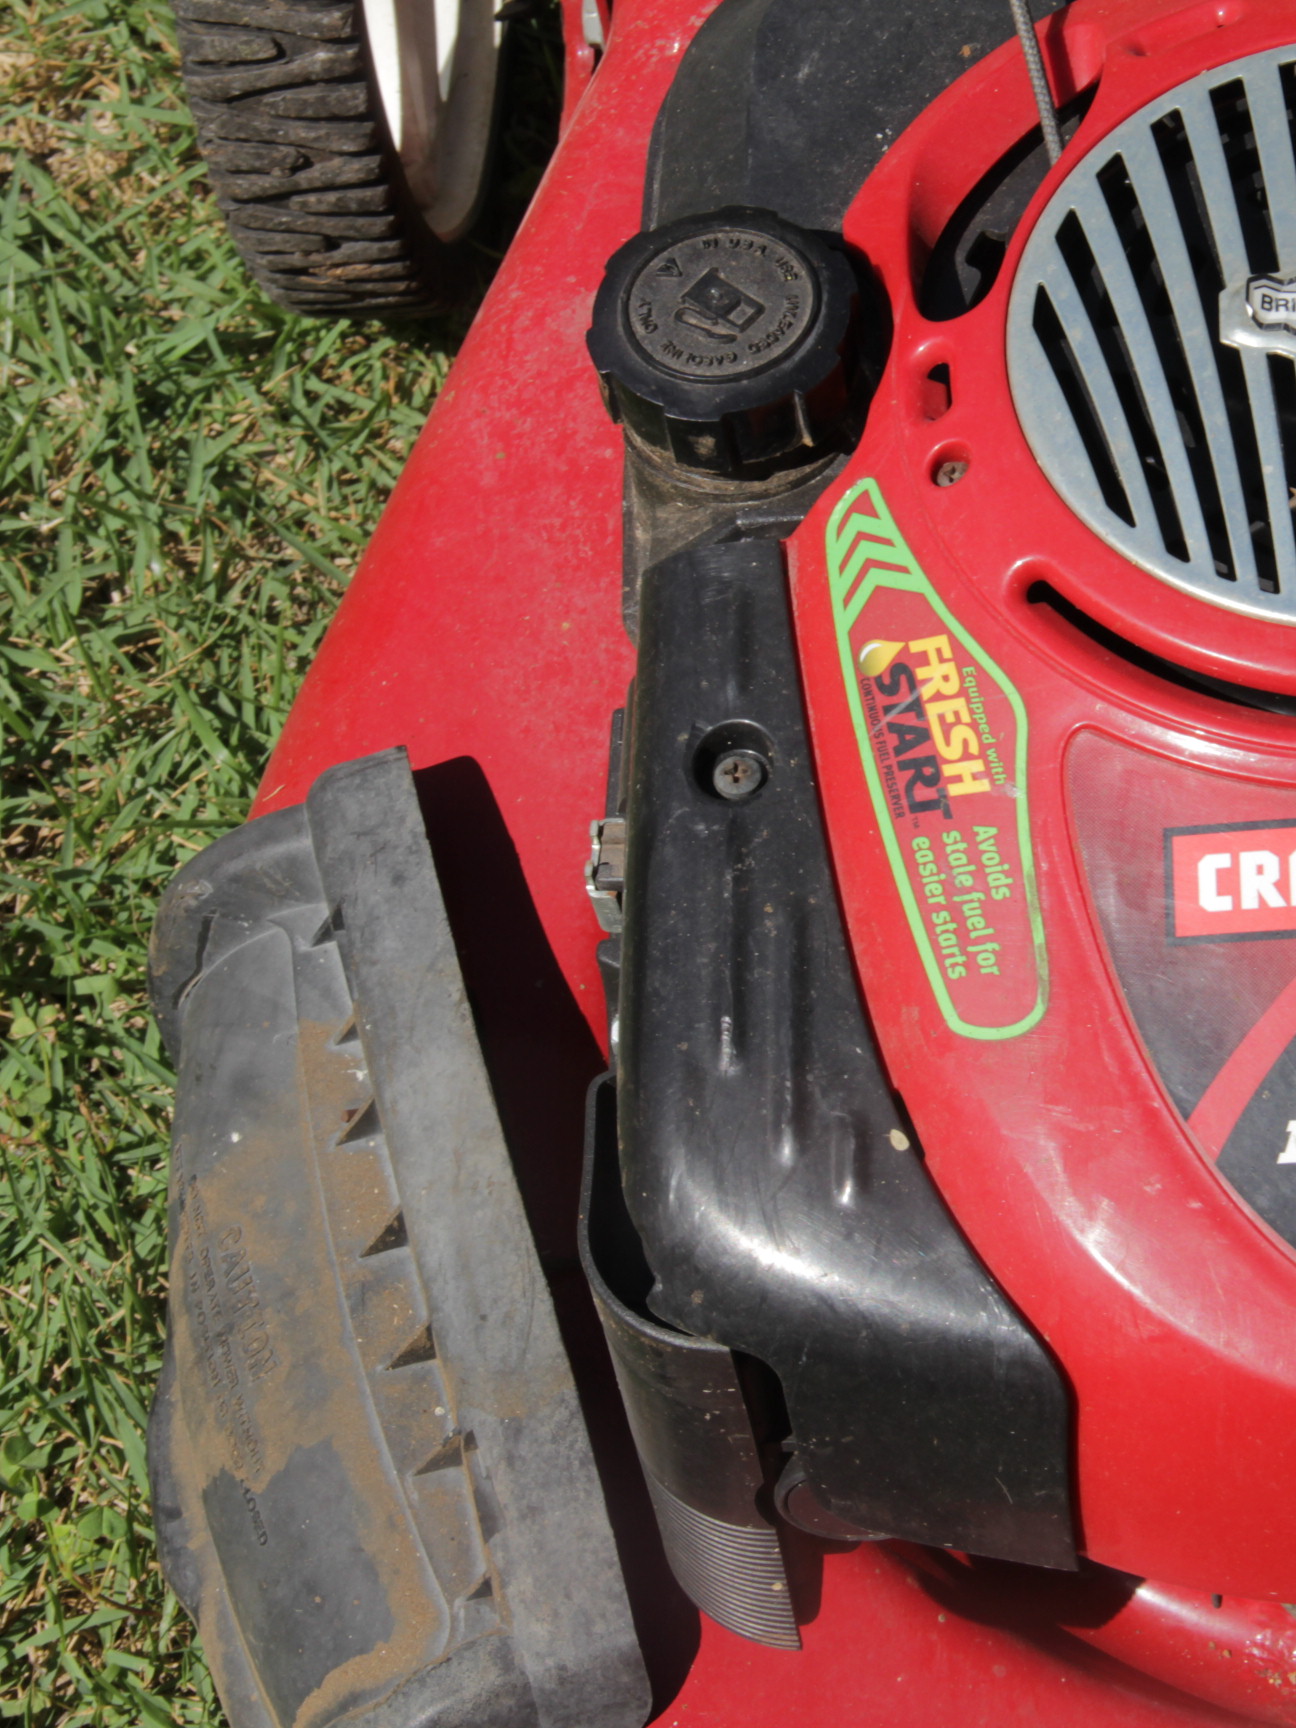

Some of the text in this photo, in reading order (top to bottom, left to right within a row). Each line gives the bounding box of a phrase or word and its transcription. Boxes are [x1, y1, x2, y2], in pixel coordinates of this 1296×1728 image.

[638, 299, 659, 334] ONLY
[661, 340, 738, 366] GASOLINE
[860, 678, 906, 819] CONTINUOUS FUEL PRESERVER
[874, 662, 953, 819] START
[908, 634, 991, 797] FRESH
[962, 666, 1007, 785] Equipped with
[912, 836, 967, 980] easier starts
[942, 830, 1000, 975] stale fuel for
[972, 826, 1014, 900] Avoids
[218, 1225, 277, 1382] CAUTION
